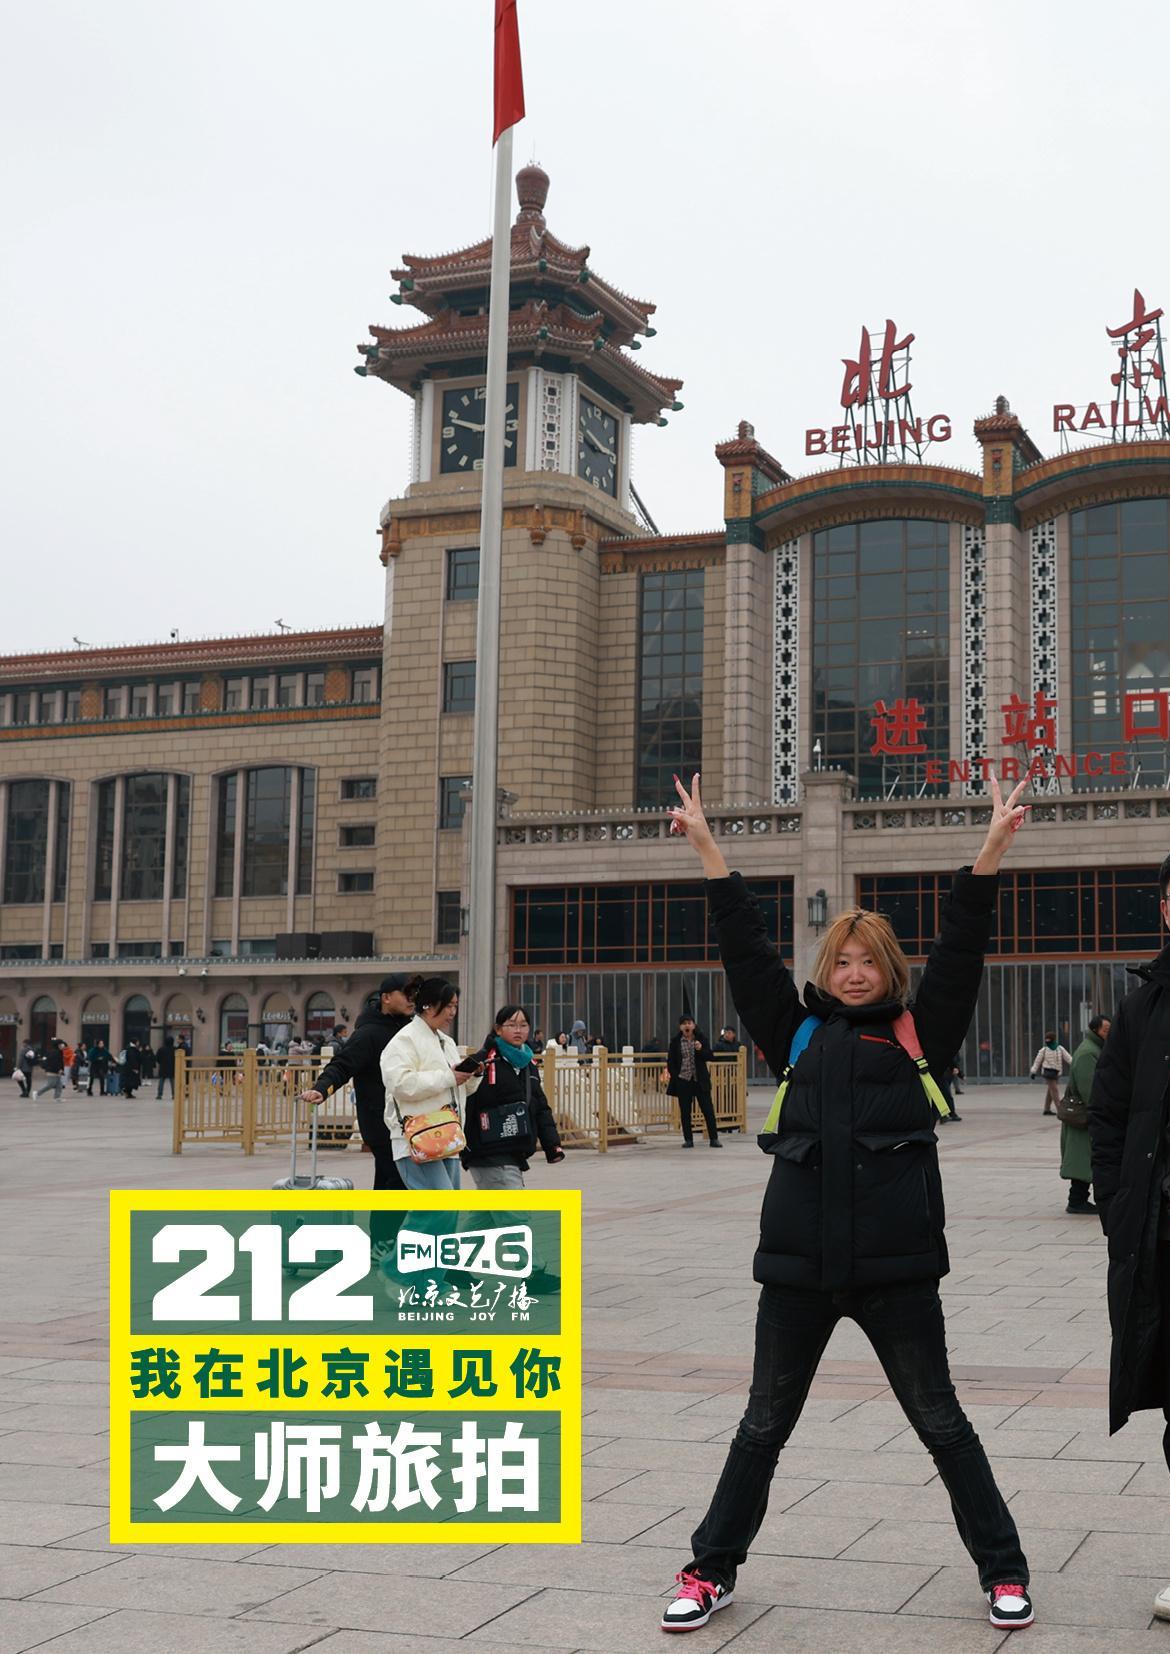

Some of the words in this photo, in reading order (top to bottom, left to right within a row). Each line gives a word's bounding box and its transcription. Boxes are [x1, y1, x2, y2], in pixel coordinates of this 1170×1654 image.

[442, 426, 455, 439] 9
[506, 419, 519, 432] 3
[805, 414, 952, 456] BEIJING
[870, 691, 1169, 757] 进站口
[925, 751, 1128, 784] ENTRANCE
